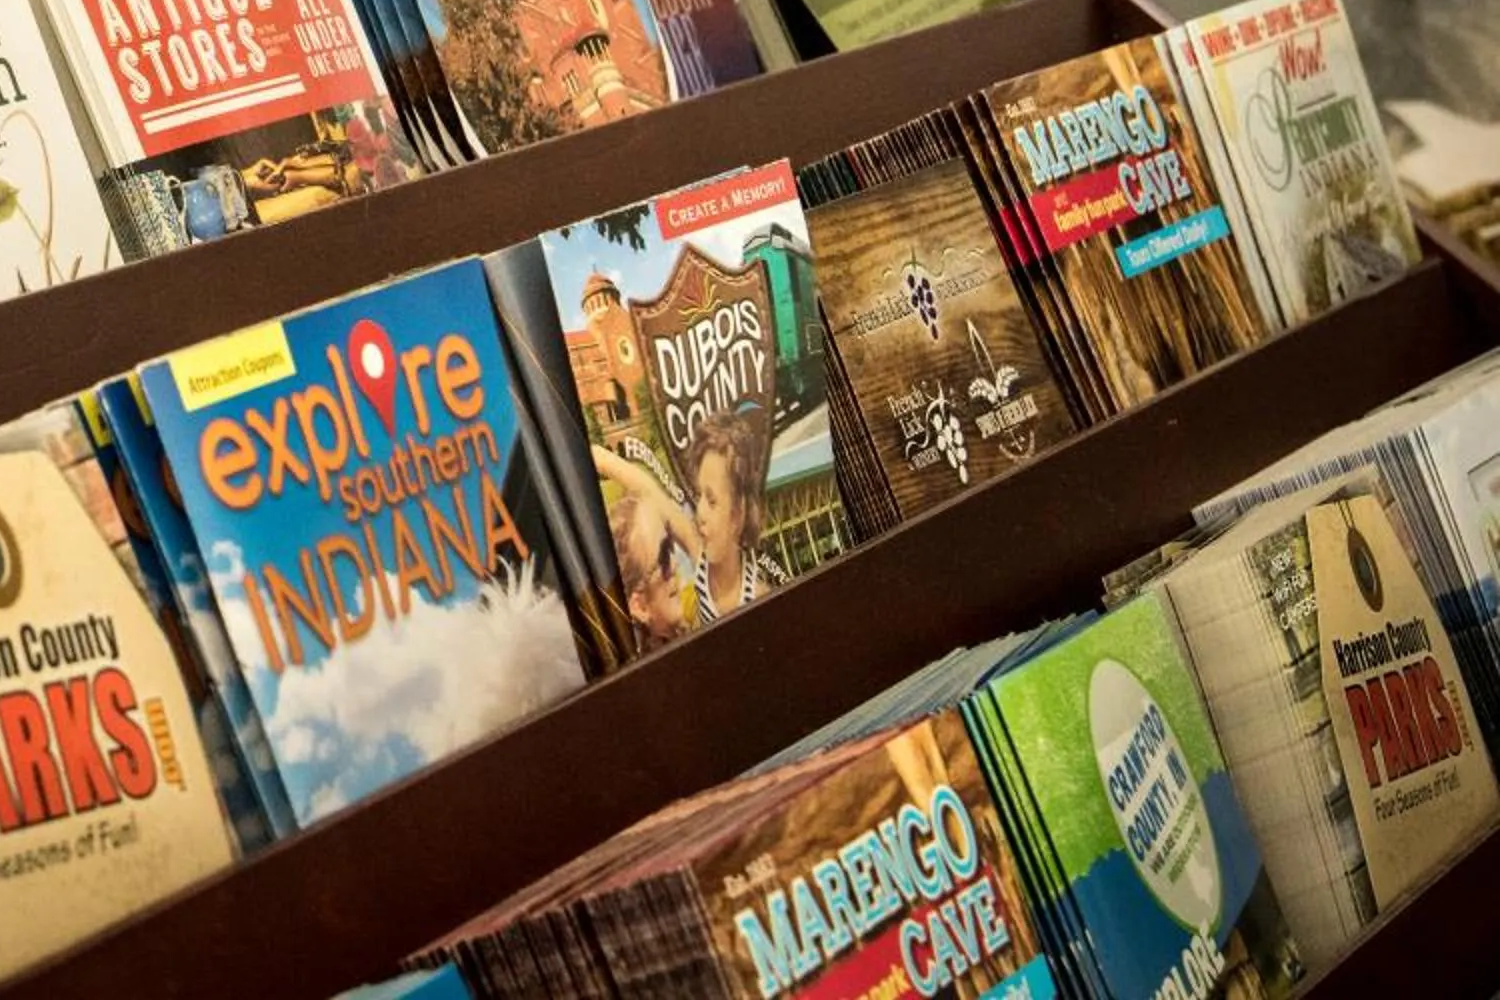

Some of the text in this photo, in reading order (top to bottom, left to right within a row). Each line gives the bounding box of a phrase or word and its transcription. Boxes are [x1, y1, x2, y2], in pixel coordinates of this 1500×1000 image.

[117, 17, 268, 105] STORES
[293, 15, 352, 54] UNDER
[306, 54, 335, 79] ONE
[1013, 84, 1168, 187] MARENGO
[1298, 140, 1381, 199] INDIANA
[667, 177, 787, 228] CREATE MEMORY!
[1117, 149, 1192, 215] CAVE
[654, 299, 763, 400] DUBOIS
[339, 419, 499, 524] southern
[623, 434, 685, 505] FERDINAND
[243, 470, 530, 675] INDIANA
[18, 613, 120, 675] County
[1332, 615, 1432, 679] Harrison County
[1343, 655, 1464, 790] PARKS
[1107, 703, 1166, 812] CRAWFORD
[1165, 746, 1188, 792] IN
[75, 829, 97, 860] of
[98, 813, 141, 852] Fun!
[1372, 782, 1434, 824] Four Seasons
[733, 784, 980, 1000] MARENGO
[900, 876, 1010, 999] CAVE
